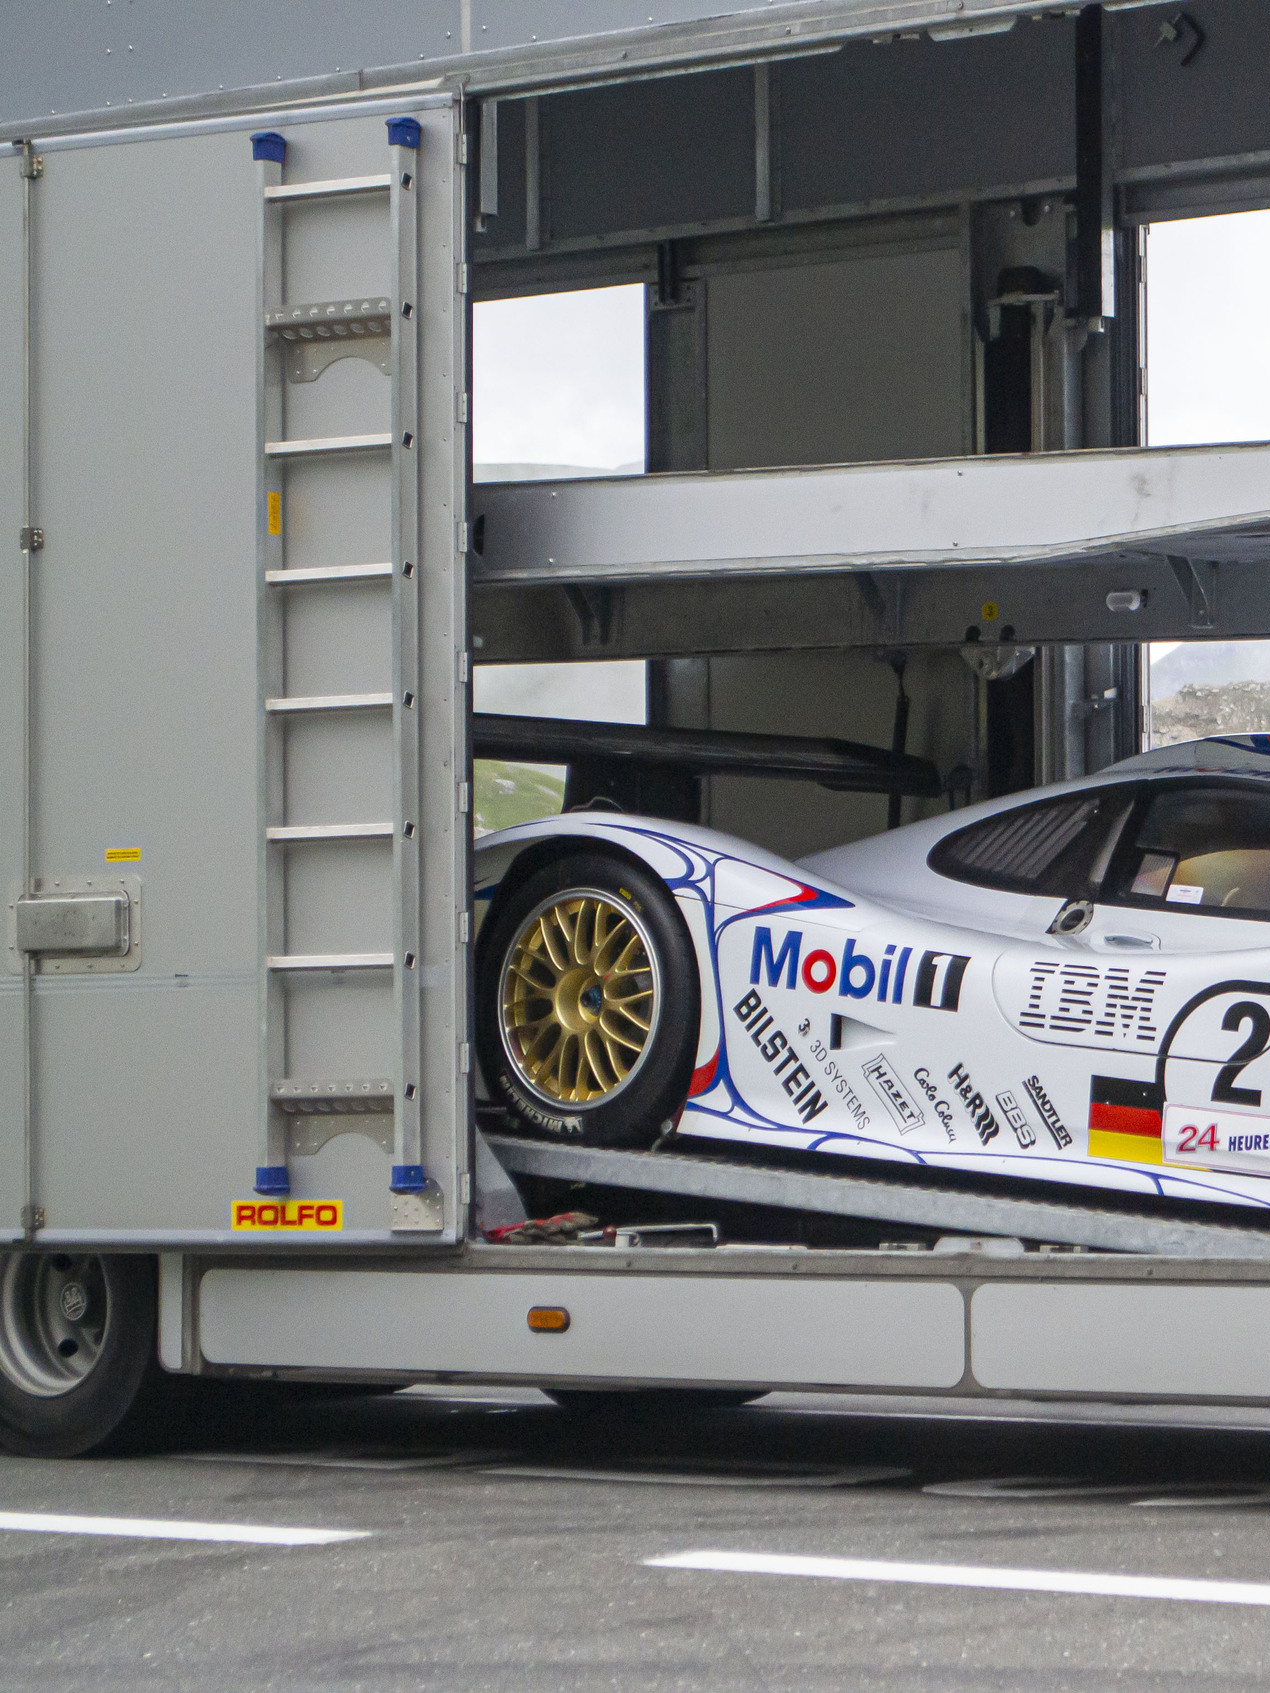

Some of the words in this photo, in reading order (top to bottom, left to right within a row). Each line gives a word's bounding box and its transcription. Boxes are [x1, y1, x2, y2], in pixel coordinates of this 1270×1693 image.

[750, 926, 913, 1004] Mobil
[931, 955, 953, 1007] 1
[1019, 962, 1167, 1041] IBM
[733, 988, 828, 1125] BILSTEIN
[810, 1040, 828, 1062] 3D
[824, 1061, 870, 1130] SYSTEMS
[914, 1068, 937, 1101] Carlo
[871, 1065, 917, 1124] HAZET
[995, 1090, 1037, 1150] BBS
[1027, 1075, 1073, 1148] SANDTLER
[1176, 1122, 1220, 1154] 24
[236, 1205, 337, 1226] ROLFO
